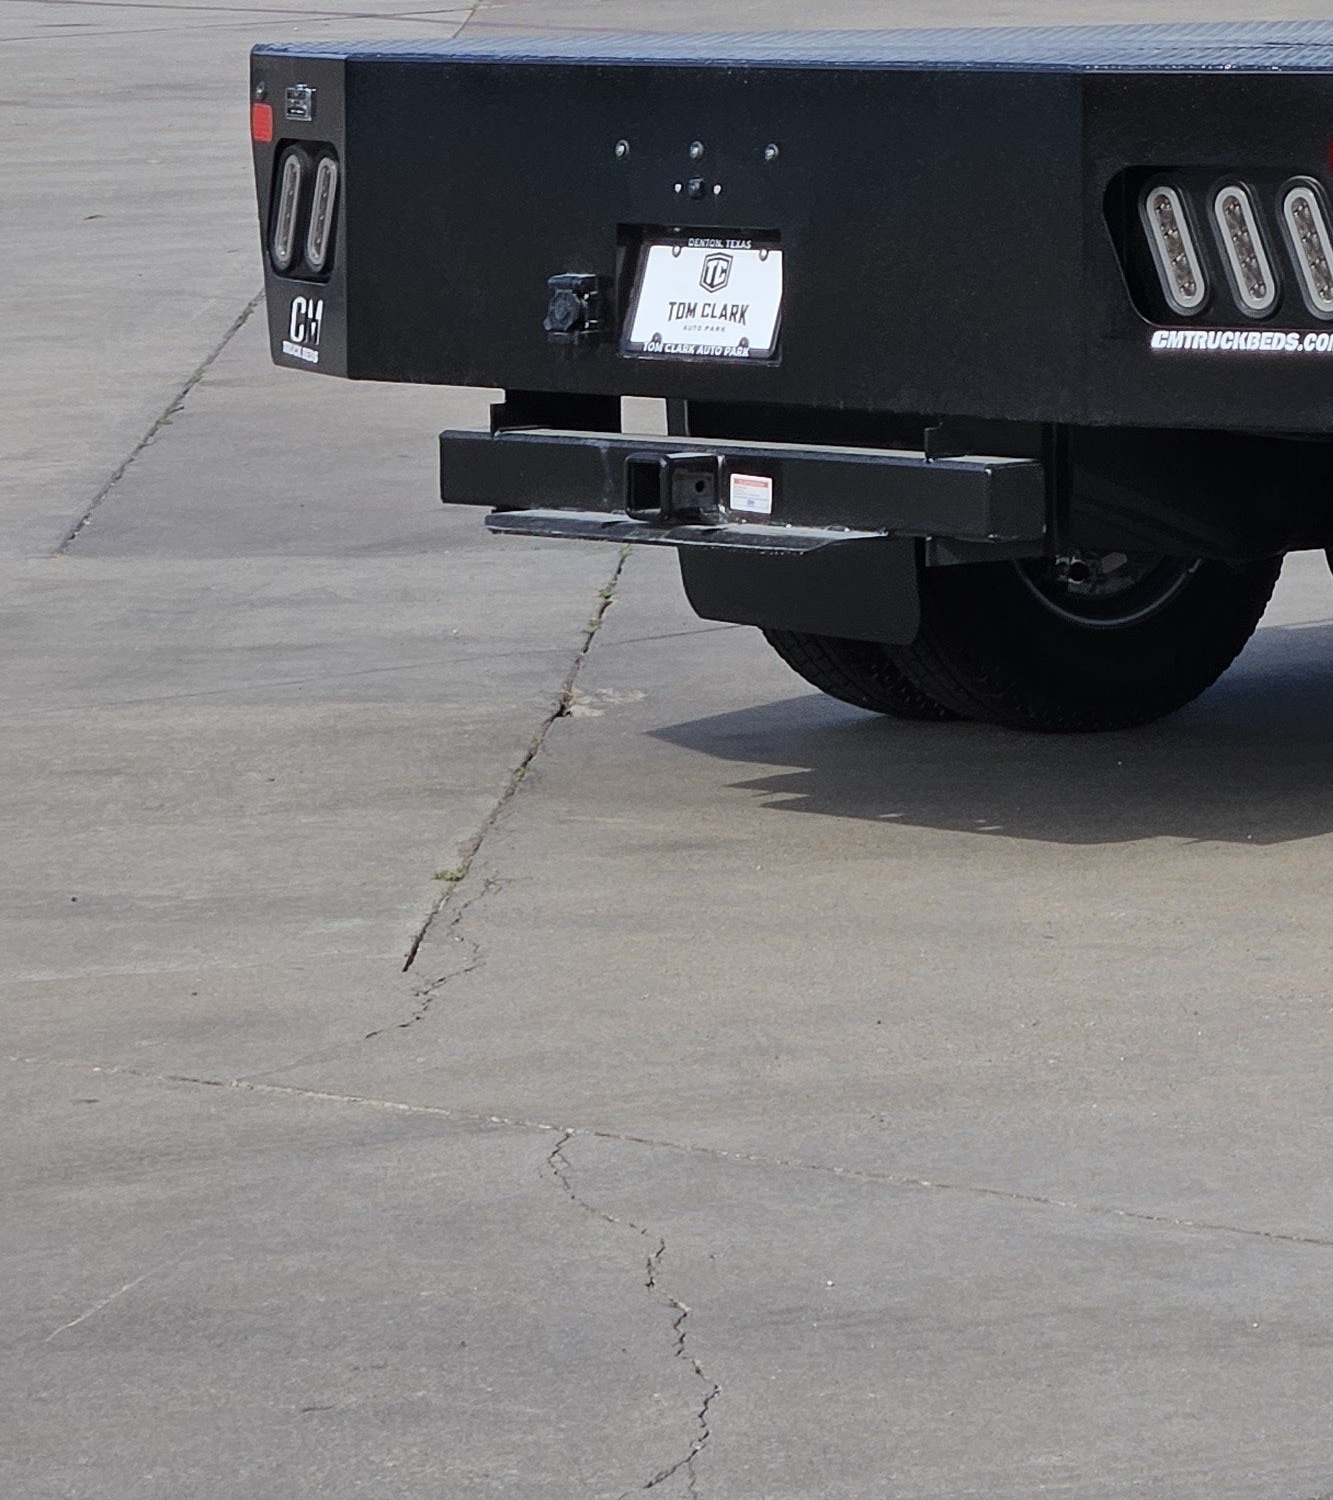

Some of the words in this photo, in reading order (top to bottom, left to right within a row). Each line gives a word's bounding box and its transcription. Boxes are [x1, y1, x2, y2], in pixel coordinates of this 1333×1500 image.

[725, 239, 752, 249] TEXAS
[667, 301, 698, 322] TOM
[701, 302, 749, 326] CLARK
[704, 325, 726, 333] PARK
[643, 341, 664, 353] TOM
[664, 342, 695, 355] CLARK
[696, 344, 722, 356] AUTO
[723, 346, 750, 357] PARK
